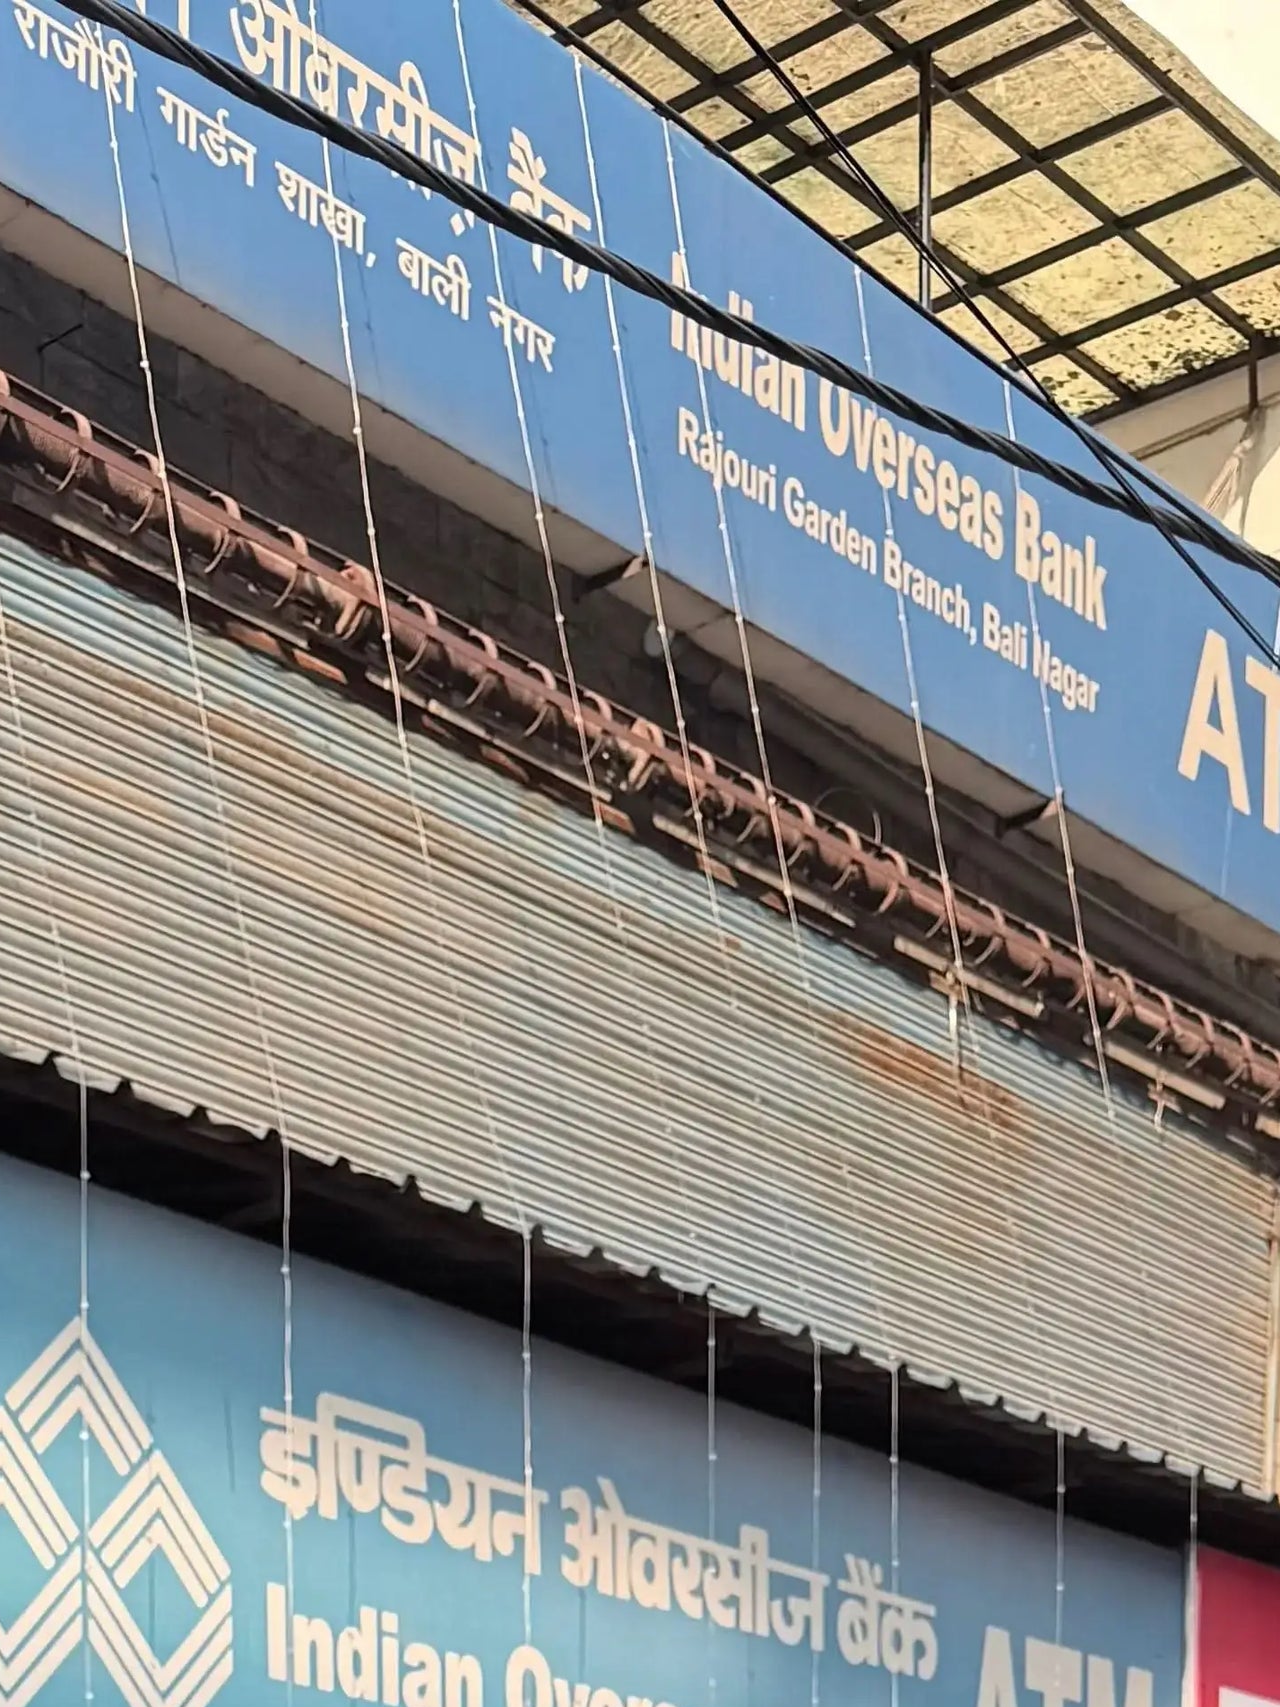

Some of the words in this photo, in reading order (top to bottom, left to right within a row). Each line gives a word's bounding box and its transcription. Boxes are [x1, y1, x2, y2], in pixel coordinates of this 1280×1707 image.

[156, 87, 257, 187] गार्डन
[395, 237, 471, 321] बाली
[486, 295, 556, 373] नगर
[676, 406, 778, 511] Rajouri
[783, 478, 878, 576] Garden
[883, 532, 979, 647] Branch,
[982, 603, 1028, 669] Bali
[1032, 622, 1101, 714] Nagar
[820, 375, 1005, 561] Overseas
[1014, 487, 1109, 631] Bank
[835, 1553, 939, 1682] बैंक
